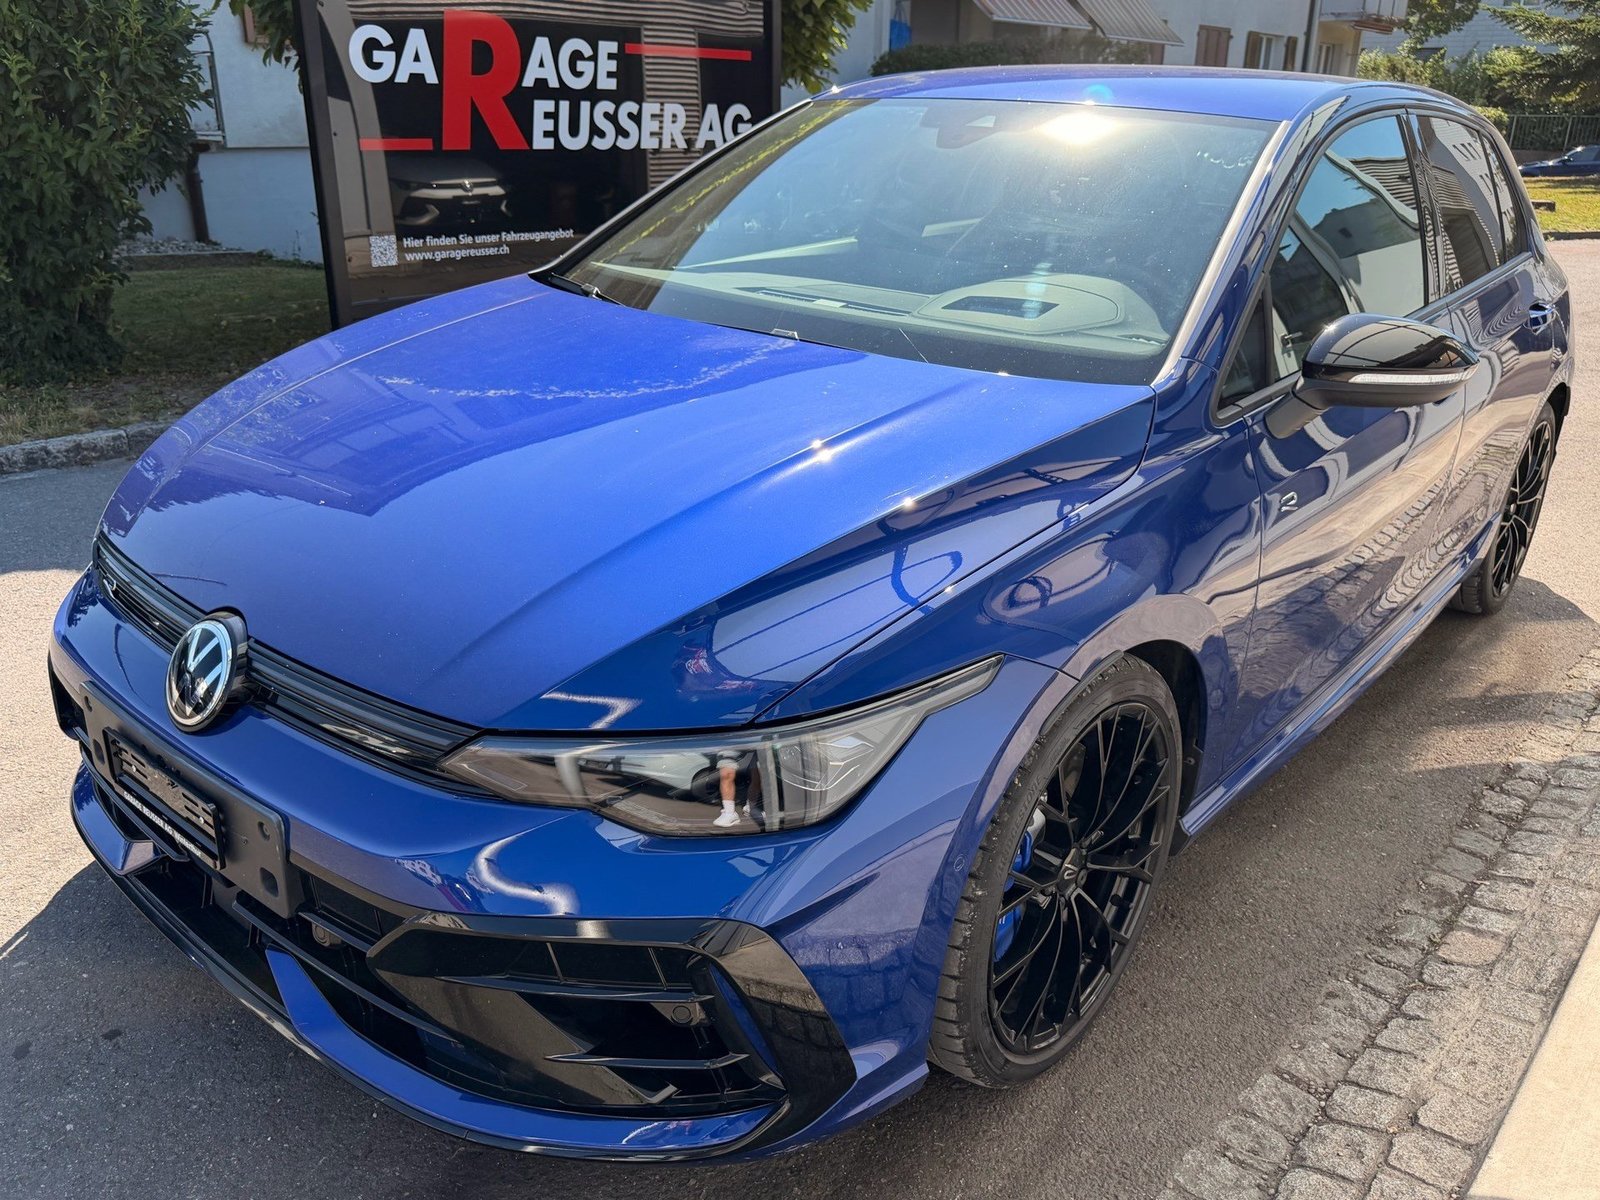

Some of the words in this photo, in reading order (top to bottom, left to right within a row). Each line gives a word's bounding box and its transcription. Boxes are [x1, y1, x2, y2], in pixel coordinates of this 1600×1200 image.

[348, 9, 618, 150] GARAGE
[695, 103, 752, 149] AG
[403, 236, 424, 248] Hier
[426, 234, 457, 247] finden
[459, 234, 473, 244] Sie
[475, 233, 500, 243] unser
[501, 228, 574, 242] Fahrzeugangebot
[405, 244, 510, 261] www.garagereusser.ch
